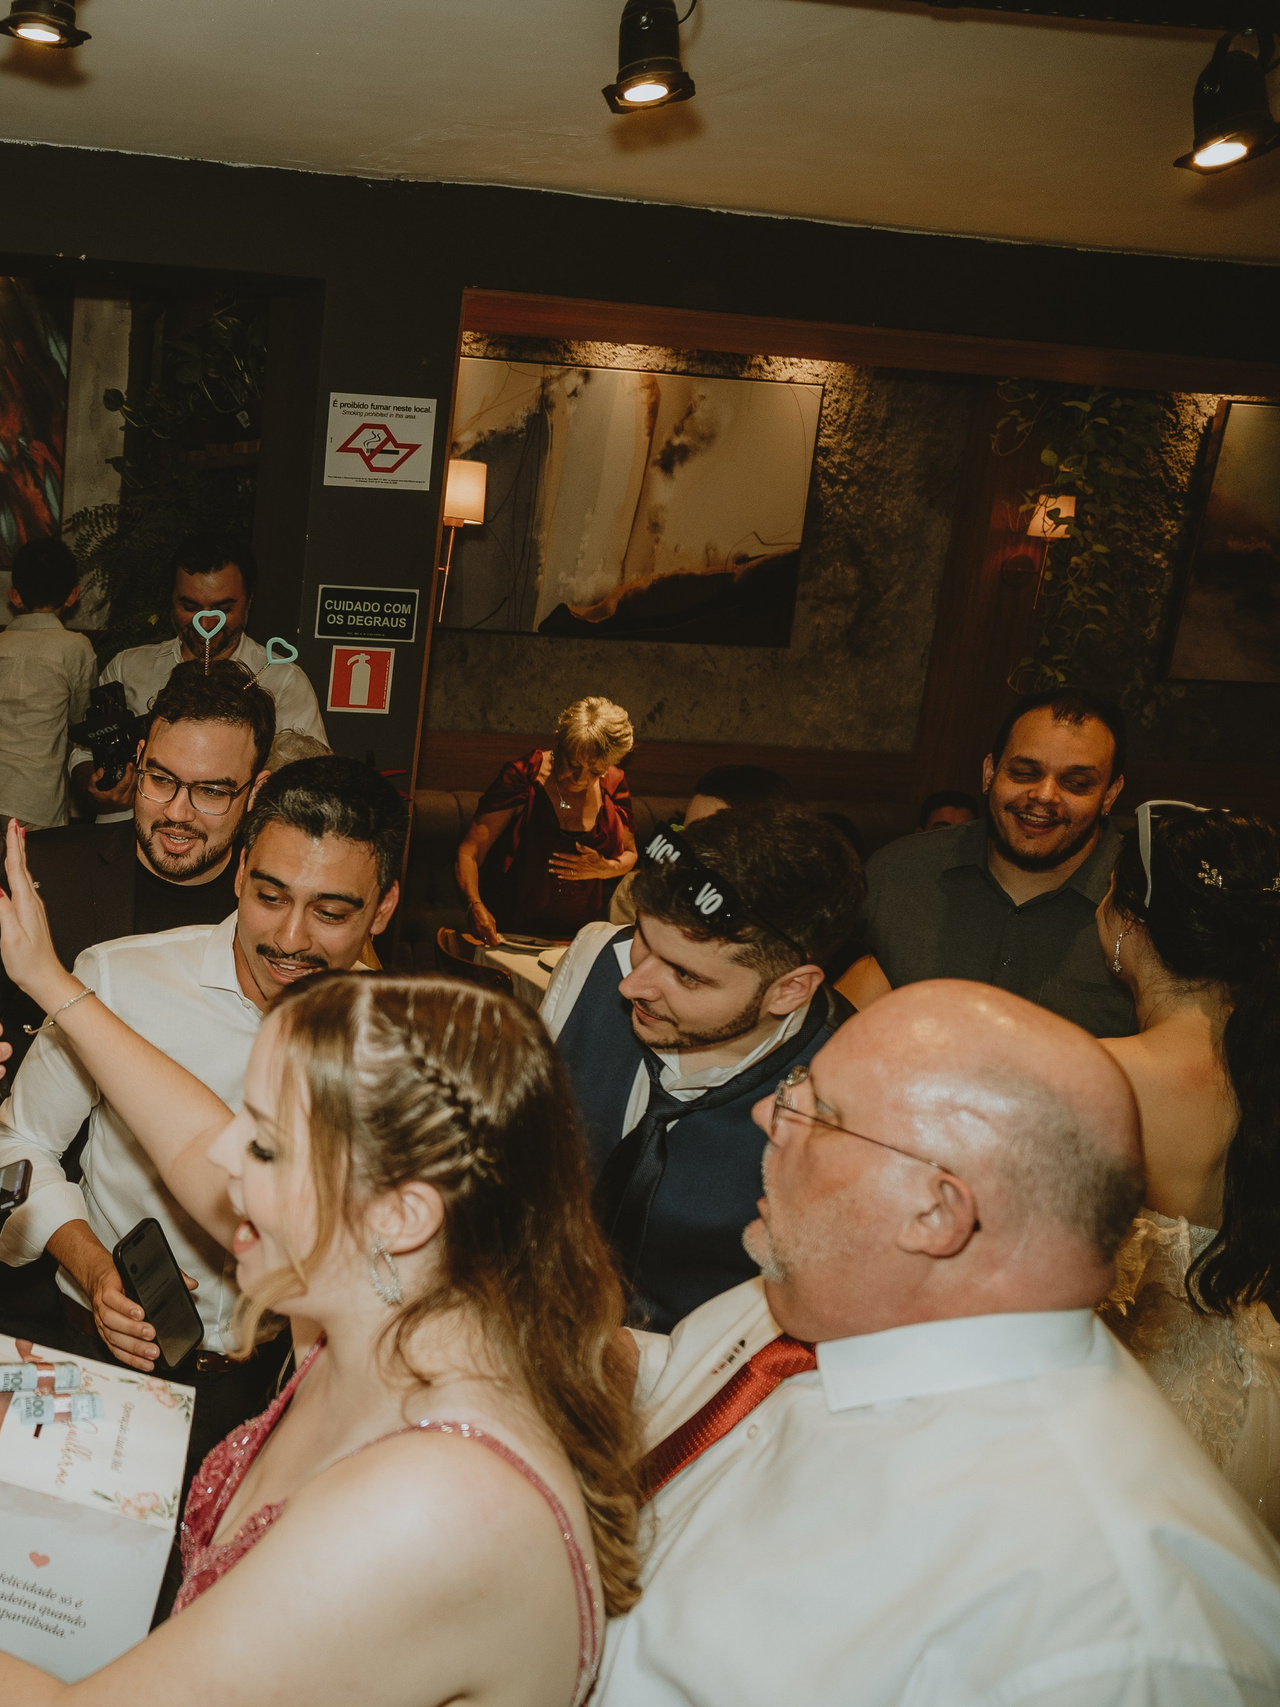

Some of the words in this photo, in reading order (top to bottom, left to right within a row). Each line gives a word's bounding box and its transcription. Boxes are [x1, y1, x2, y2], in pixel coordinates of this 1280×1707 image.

[332, 399, 338, 407] É
[339, 401, 369, 410] proibido
[370, 402, 391, 411] fumar
[341, 409, 363, 417] Smoking
[325, 599, 380, 612] CUIDADO
[383, 603, 412, 614] COM
[326, 614, 344, 625] OS
[347, 615, 407, 628] DEGRAUS
[694, 882, 724, 915] VO
[59, 1592, 73, 1606] só
[74, 1598, 83, 1610] é
[39, 1602, 87, 1629] quando
